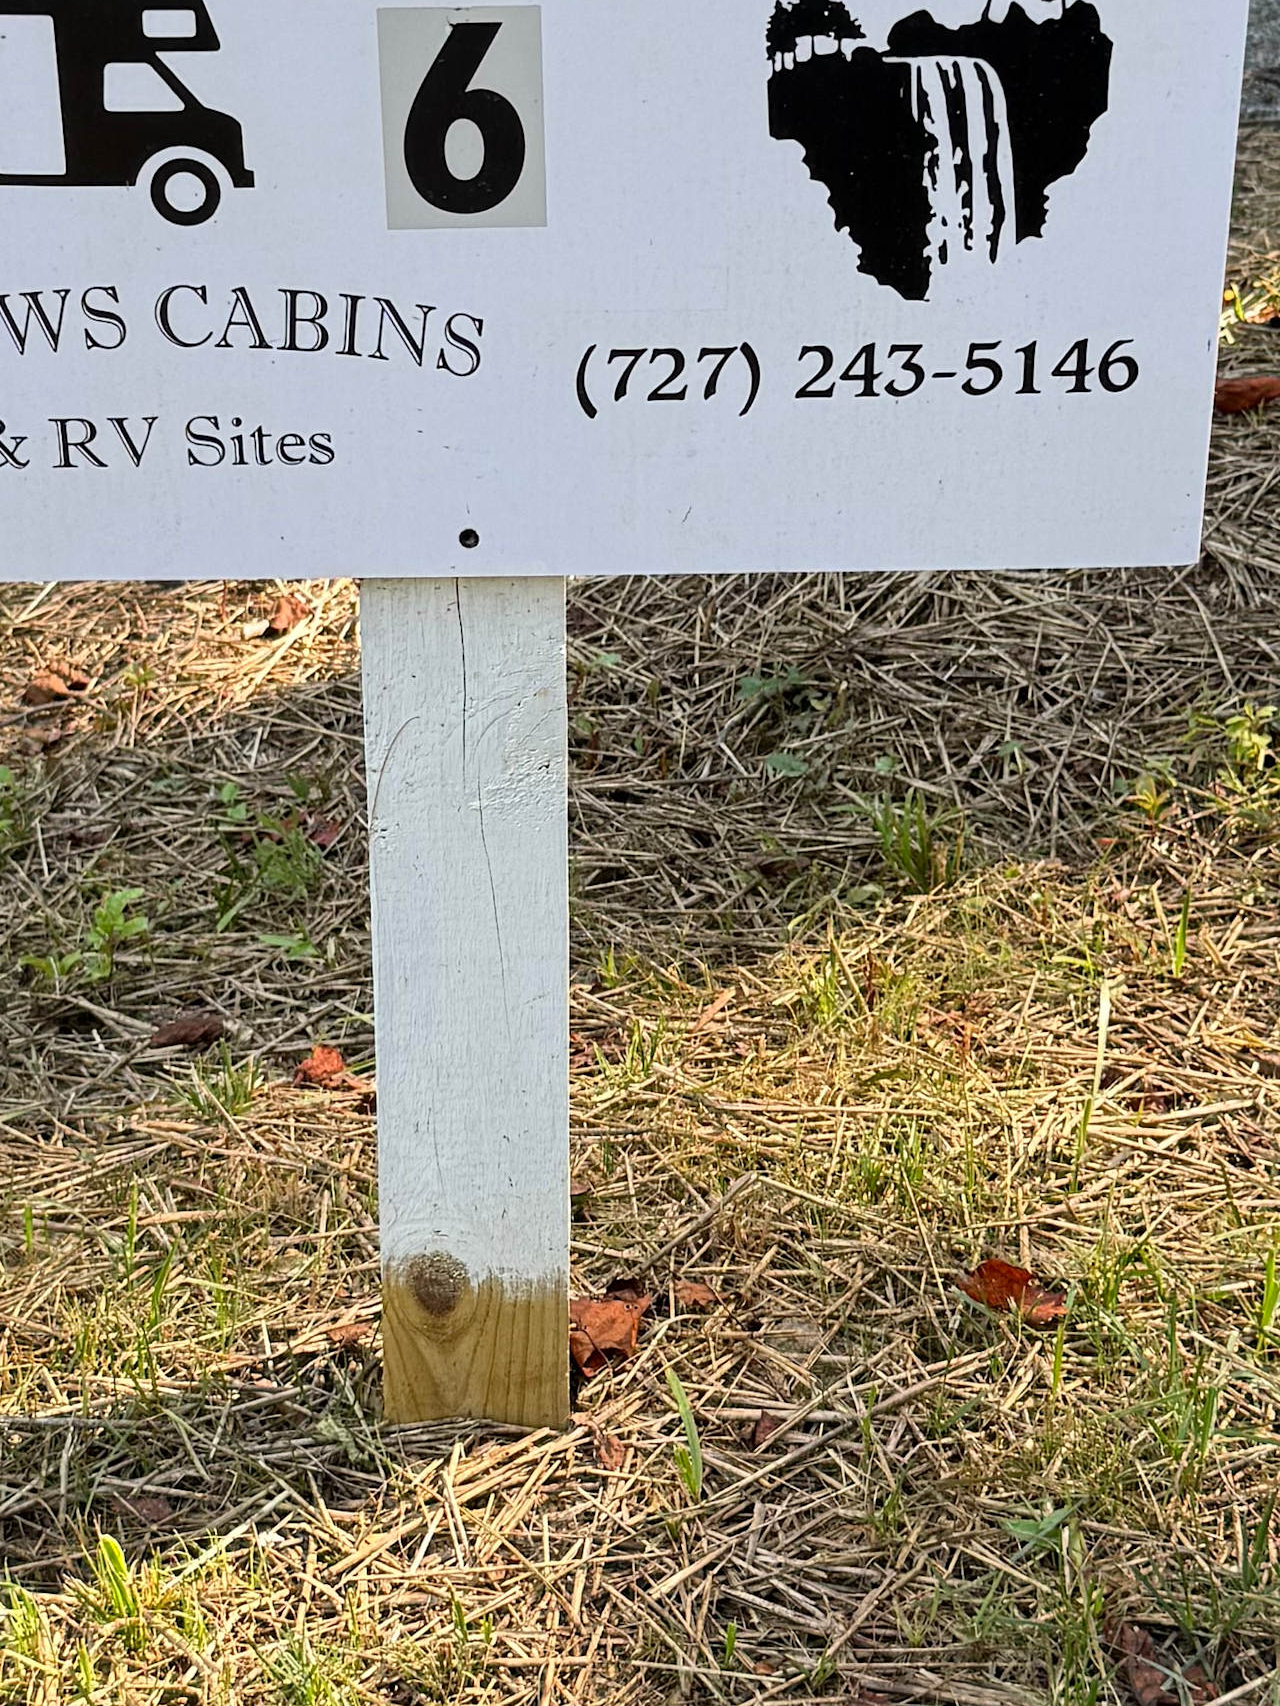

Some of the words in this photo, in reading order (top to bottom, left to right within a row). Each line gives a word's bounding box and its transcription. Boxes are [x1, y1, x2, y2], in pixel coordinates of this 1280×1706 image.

[404, 22, 525, 214] 6
[155, 285, 483, 376] CABINS
[576, 342, 760, 419] (727)
[795, 338, 1138, 398] 243-5146
[48, 416, 158, 468] RV
[186, 416, 334, 466] Sites
